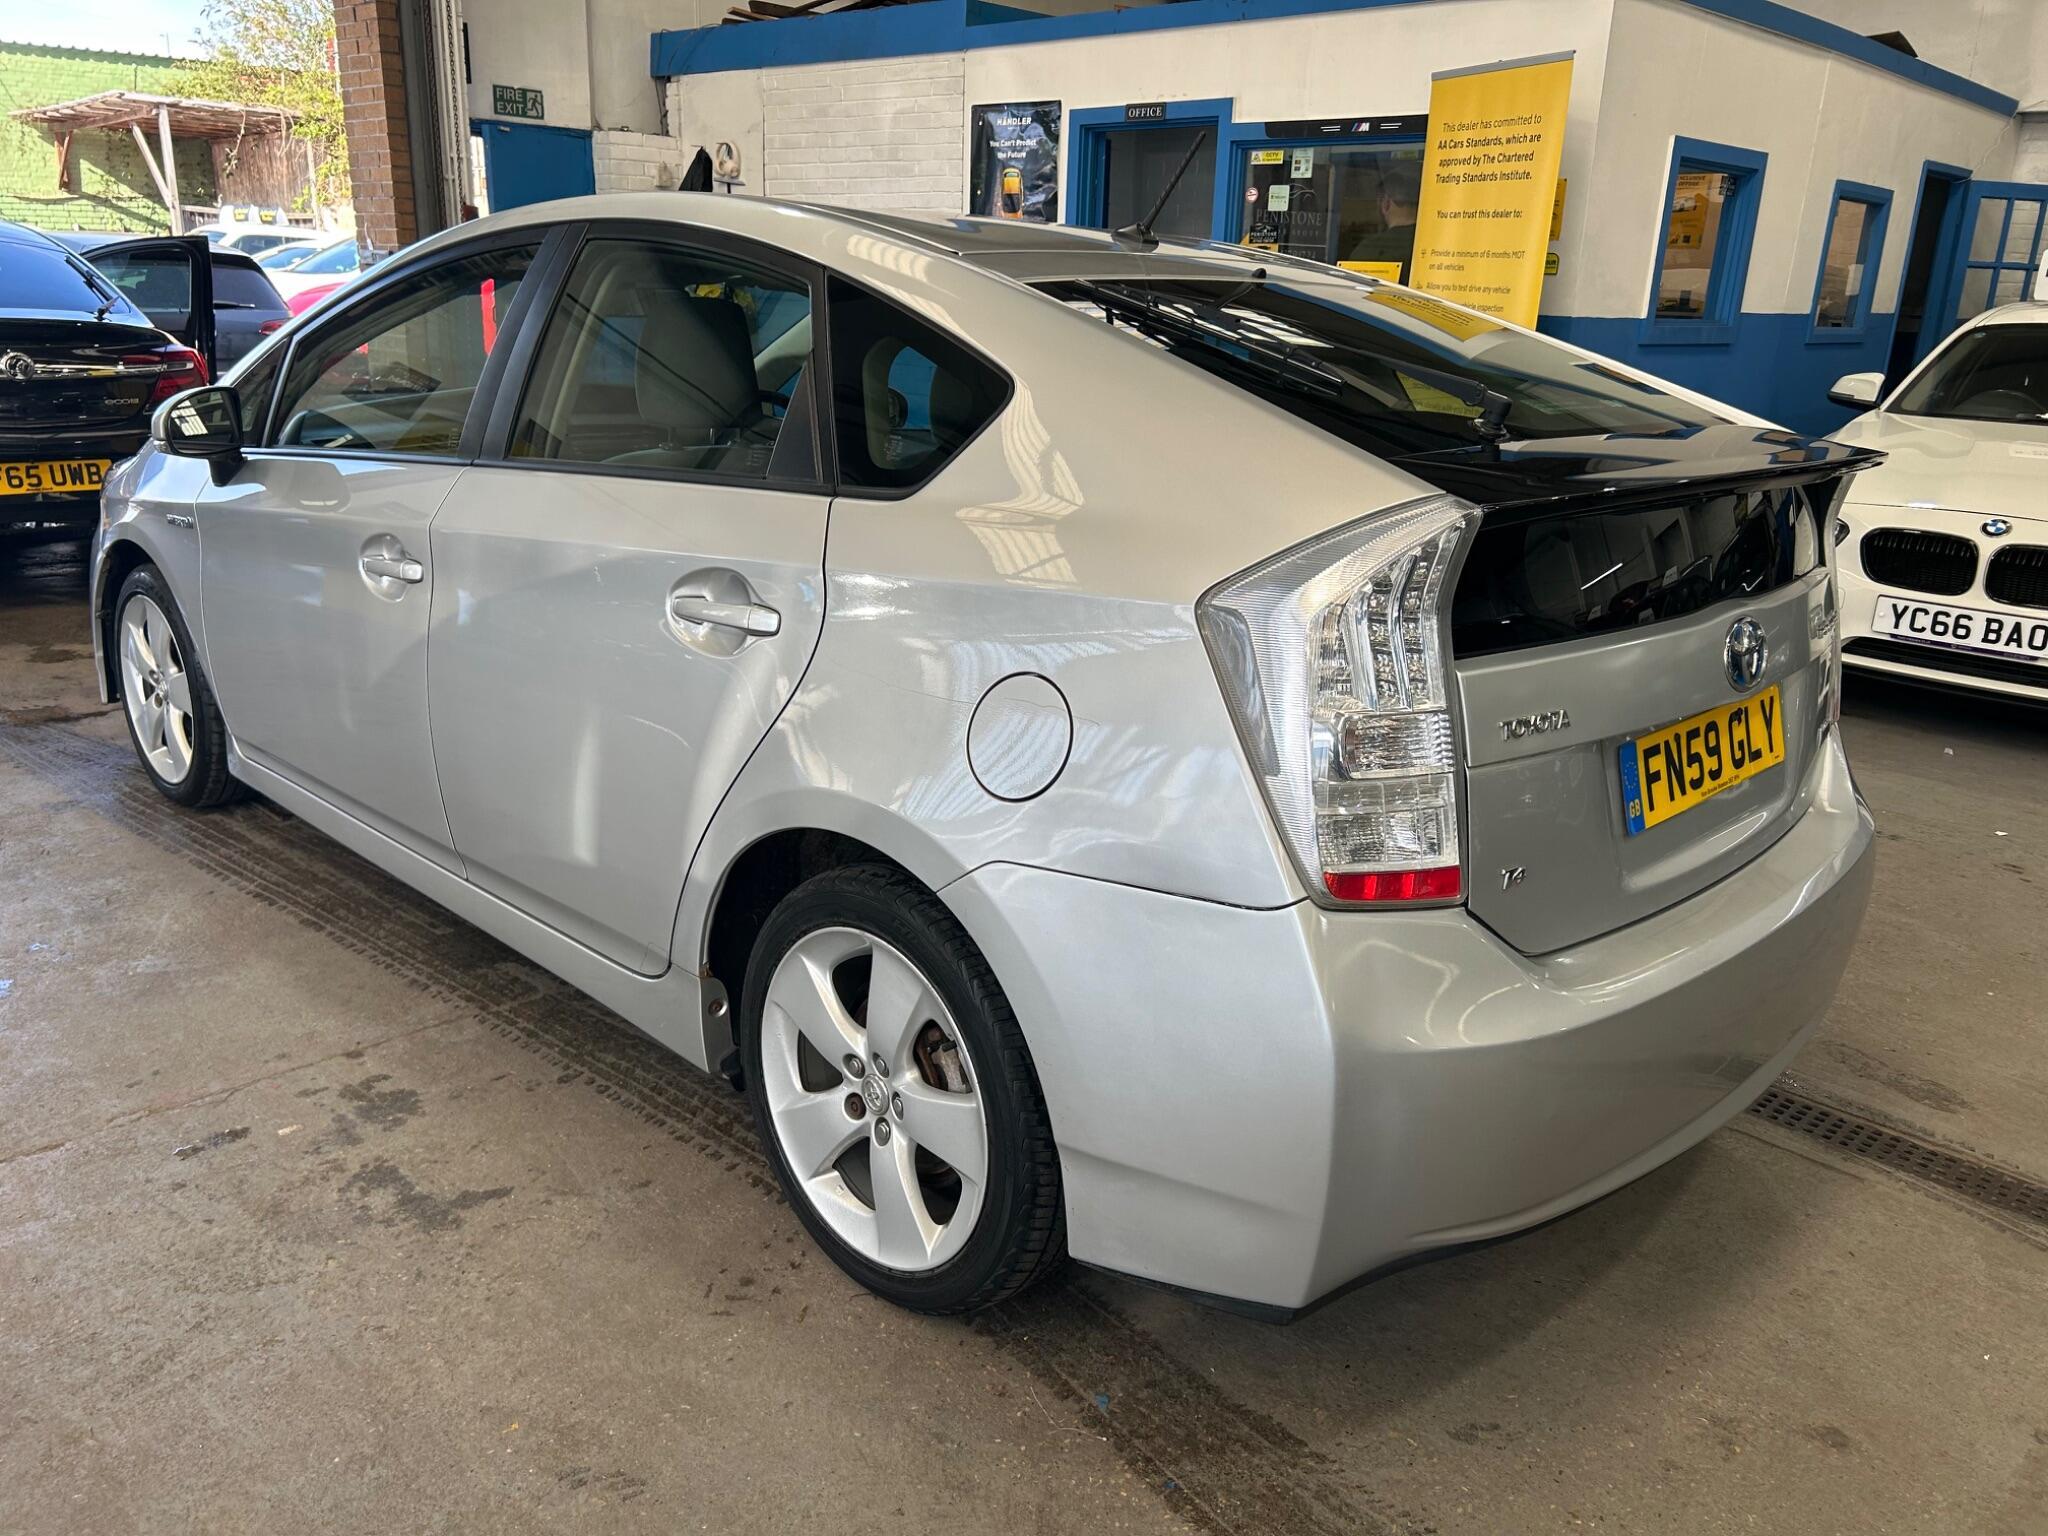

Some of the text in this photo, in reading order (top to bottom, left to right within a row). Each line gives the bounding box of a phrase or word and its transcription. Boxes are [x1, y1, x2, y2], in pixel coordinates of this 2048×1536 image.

[496, 87, 523, 102] FIRE
[496, 101, 524, 115] EXIT
[1128, 107, 1163, 118] OFFICE
[1443, 113, 1542, 132] This dealer has committed to
[989, 140, 1000, 148] You
[1438, 132, 1542, 150] AA Cars Standards, which are
[1439, 150, 1534, 168] approved by The Chartered
[1436, 170, 1532, 185] Trading Standards Institute.
[1437, 210, 1448, 219] You
[1462, 210, 1478, 218] trust
[1478, 209, 1490, 218] this
[1492, 209, 1512, 218] dealer
[1430, 248, 1451, 258] Provide
[1456, 250, 1479, 258] minimum
[1480, 250, 1486, 258] of
[1491, 250, 1511, 259] months
[1512, 251, 1526, 259] MOT
[1459, 284, 1468, 292] test
[1469, 284, 1482, 293] drive
[1492, 286, 1511, 294] vehicle
[0, 462, 102, 489] 65 UWB
[1891, 603, 2048, 651] YC66 BAO
[1497, 709, 1570, 741] TOYOTA
[1642, 695, 1774, 812] FN59 GLY
[1629, 798, 1641, 818] GB
